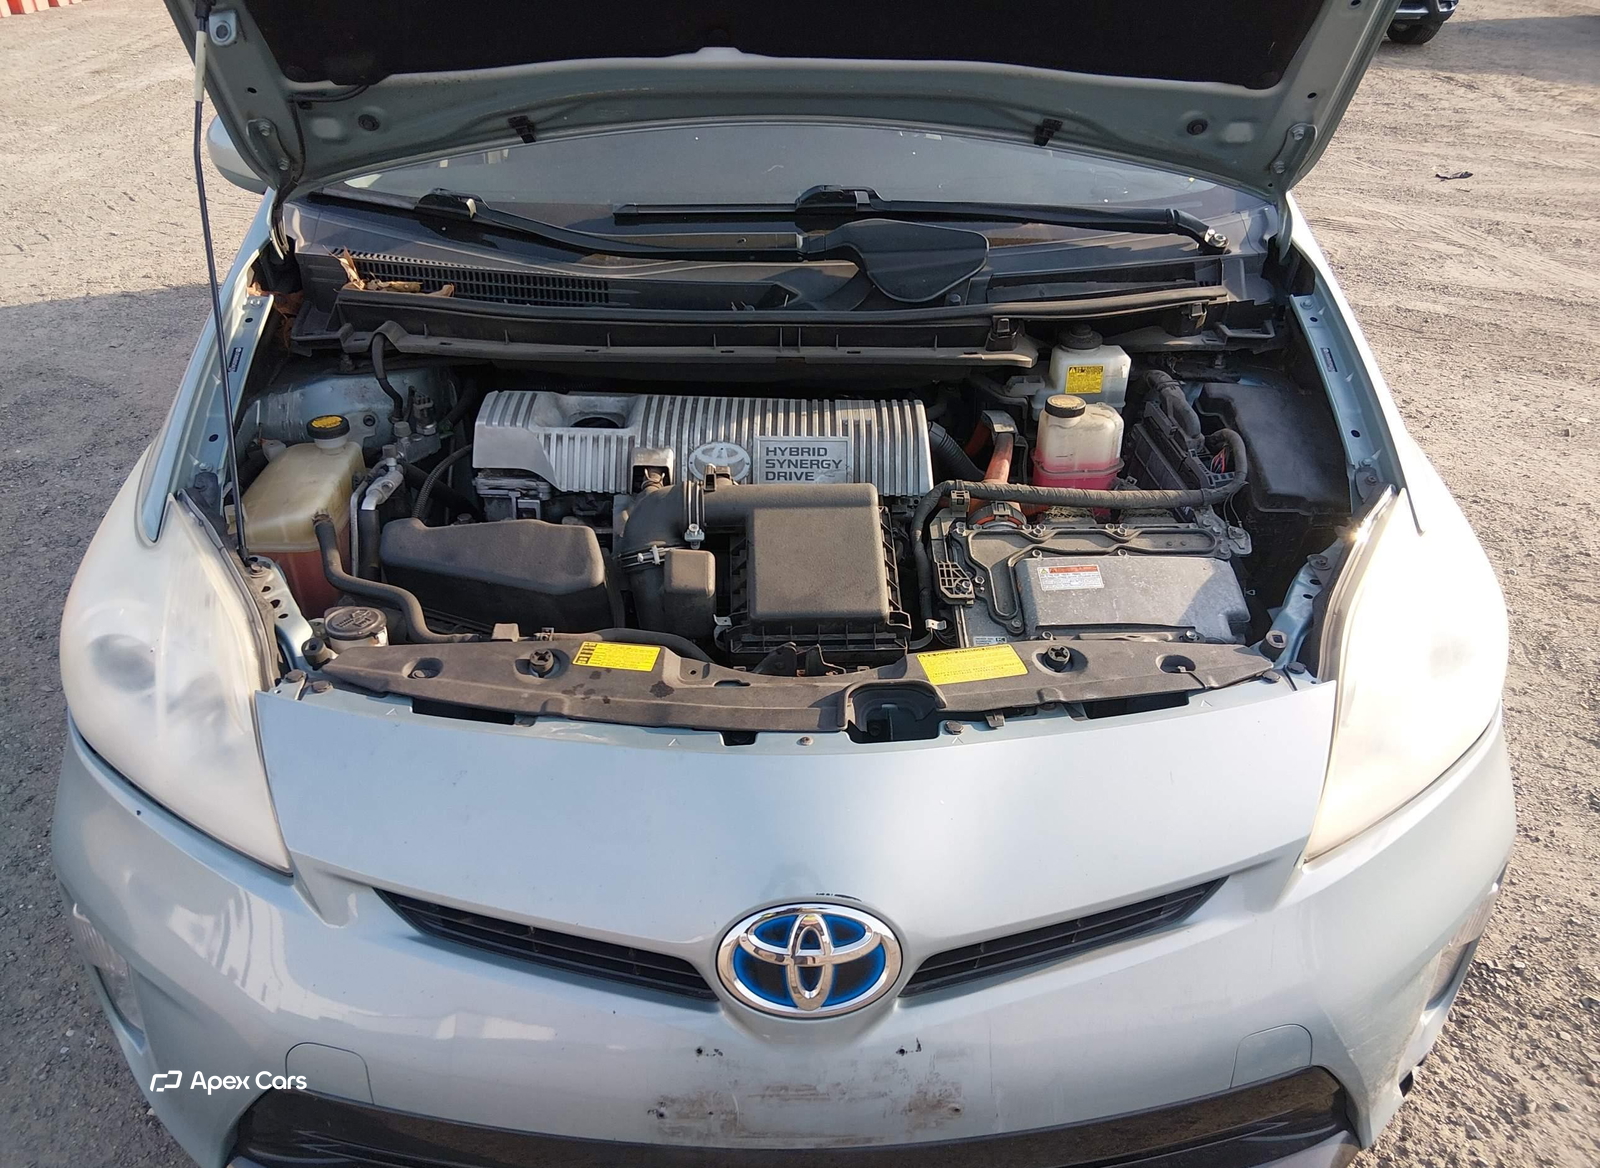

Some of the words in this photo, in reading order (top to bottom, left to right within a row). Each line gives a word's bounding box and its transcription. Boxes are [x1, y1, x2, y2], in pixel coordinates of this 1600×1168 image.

[765, 447, 828, 457] HYBRID
[765, 458, 843, 470] SYNERGY
[765, 471, 815, 481] DRIVE
